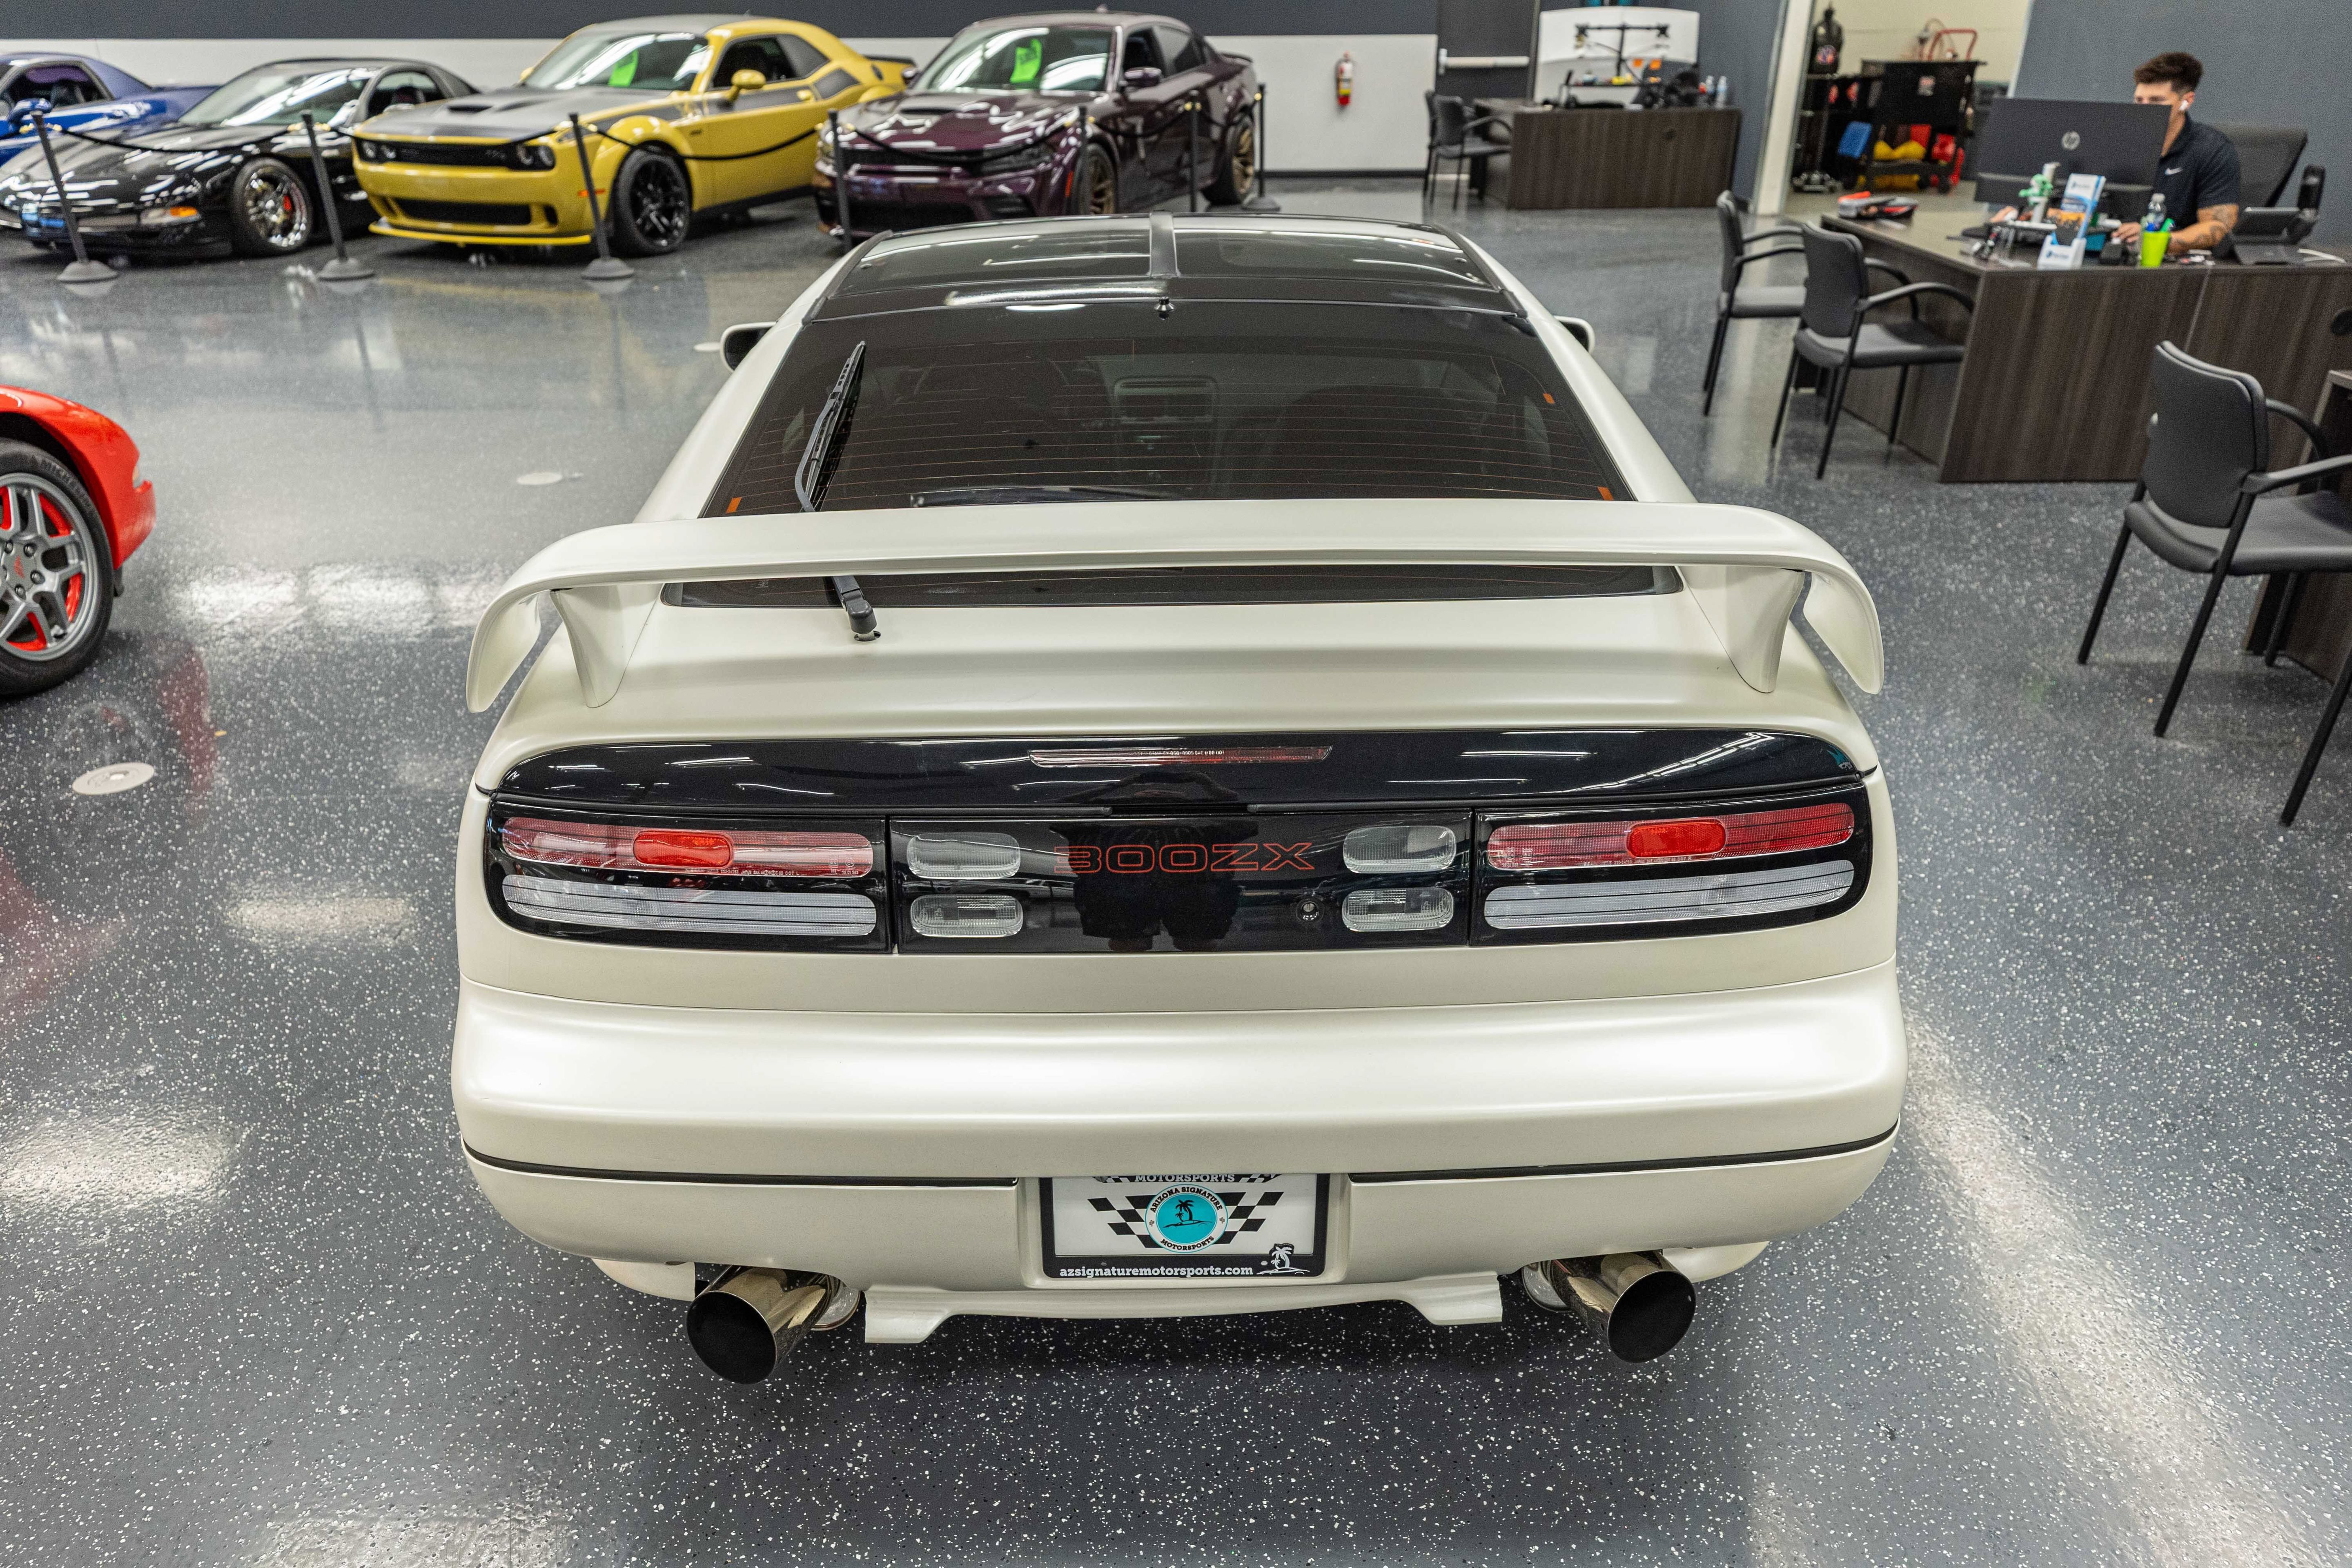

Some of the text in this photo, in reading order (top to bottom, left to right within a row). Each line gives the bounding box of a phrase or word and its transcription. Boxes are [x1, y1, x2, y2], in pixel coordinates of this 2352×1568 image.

[1054, 842, 1315, 874] 300ZX
[1134, 1174, 1235, 1182] MOTORSPORTS
[1150, 1186, 1223, 1213] ARIZONA SIGNATURE
[1160, 1236, 1215, 1251] MOTORSPORTS
[1060, 1266, 1253, 1278] azsignaturemotorsports.com
